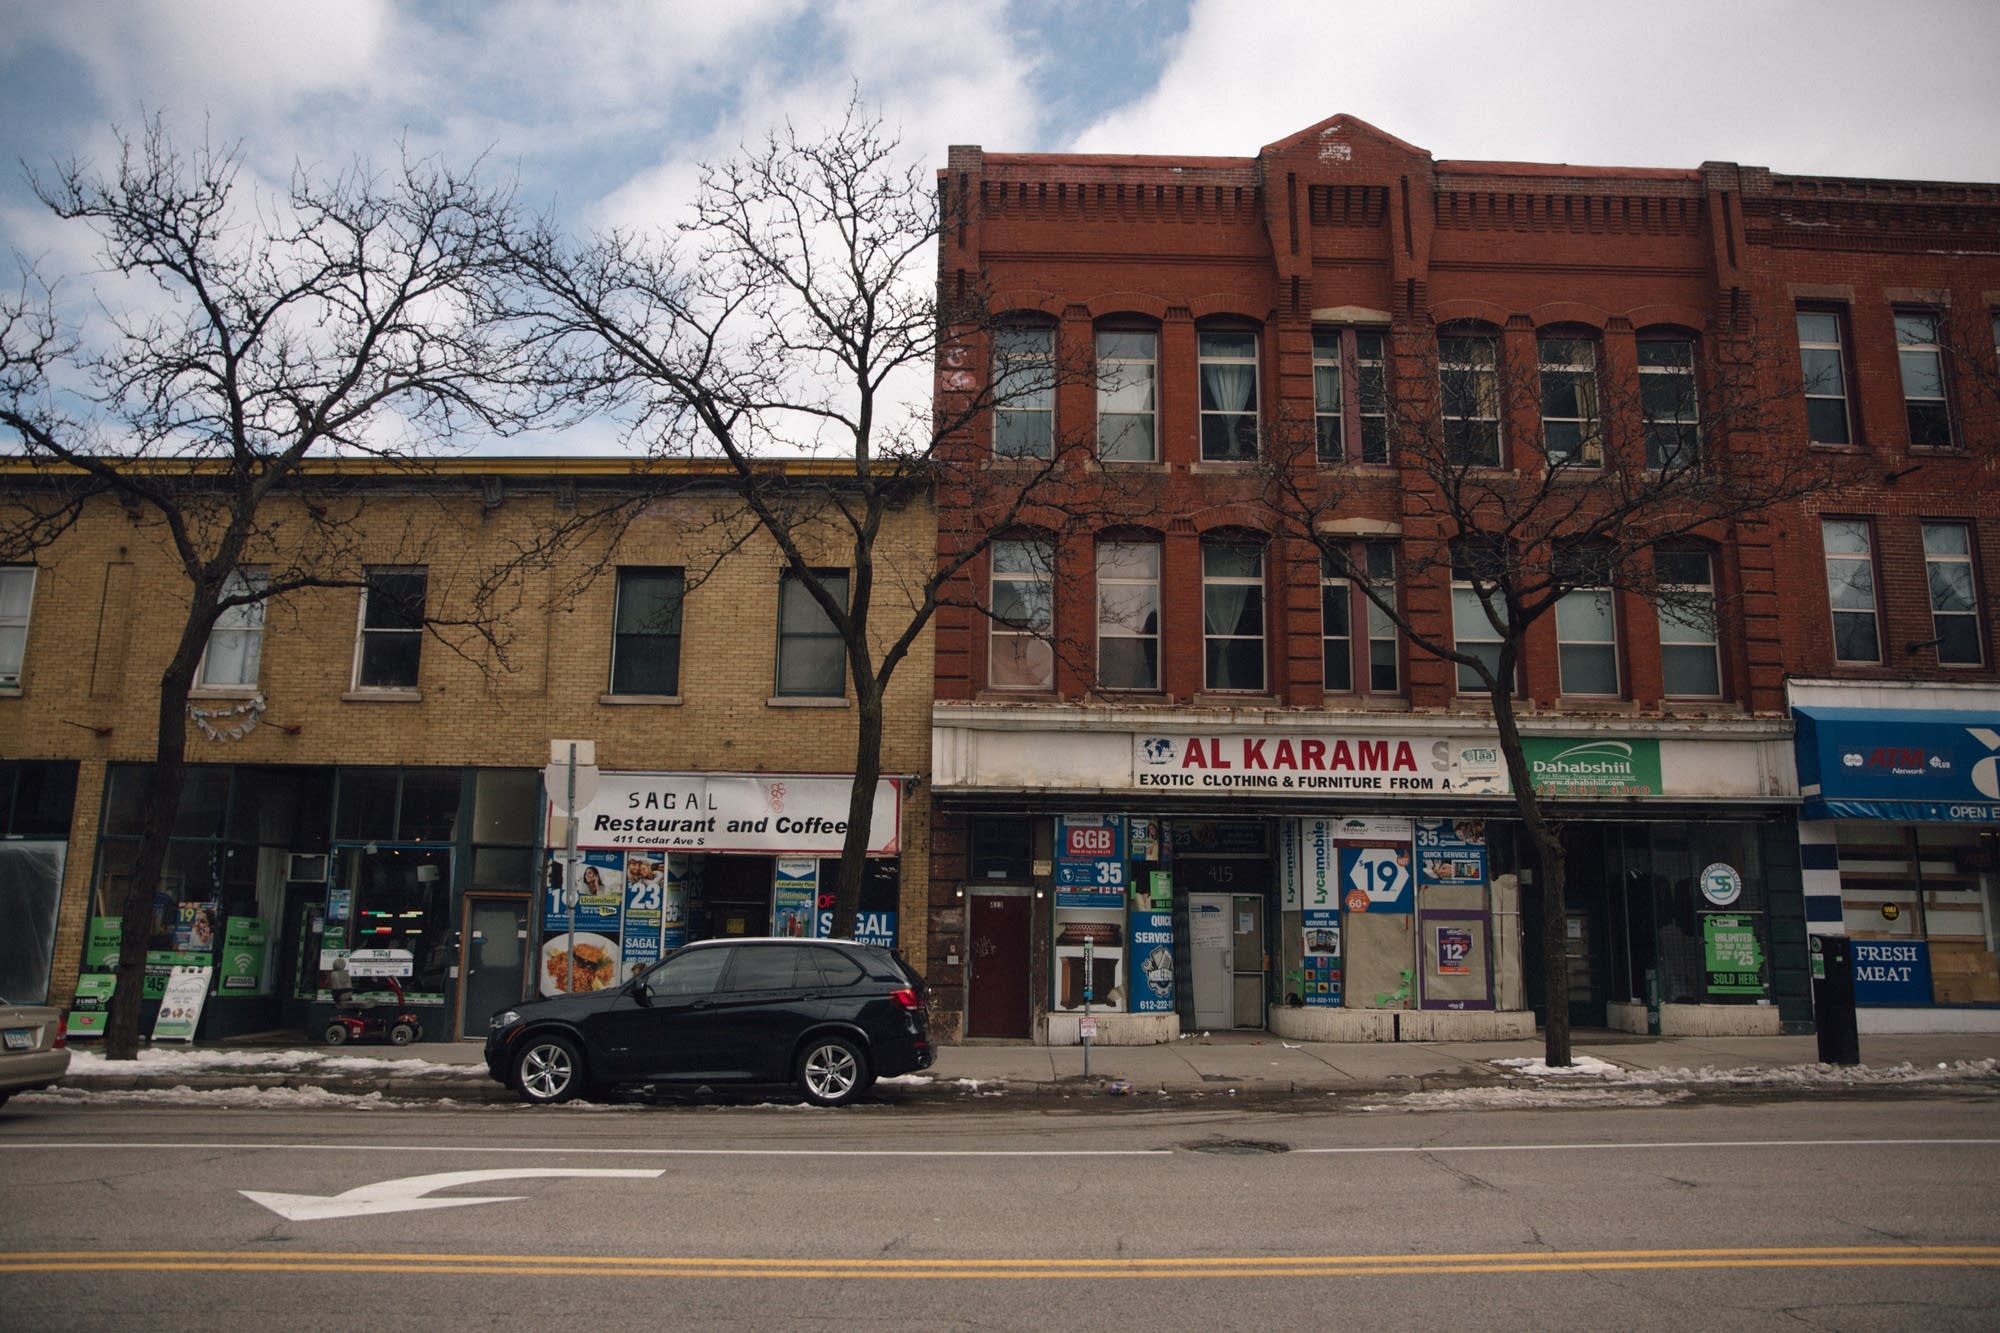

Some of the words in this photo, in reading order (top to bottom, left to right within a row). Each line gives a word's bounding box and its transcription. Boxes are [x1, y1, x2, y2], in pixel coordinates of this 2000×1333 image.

[1182, 738, 1231, 769] AL
[1243, 739, 1418, 772] KARAMA
[1868, 747, 1925, 769] ATM
[1533, 760, 1632, 774] Dahabshiil
[1139, 774, 1195, 787] EXOTIC
[1203, 775, 1280, 788] CLOTHING
[1282, 776, 1295, 789] &
[1298, 776, 1385, 790] FURNITURE
[1390, 778, 1434, 790] FROM
[629, 792, 718, 811] SAGAL
[1950, 805, 1988, 819] OPEN
[594, 814, 716, 834] Restaurant
[727, 817, 768, 834] and
[775, 817, 848, 835] Coffee
[613, 836, 633, 846] 411
[637, 837, 671, 847] Cedar
[673, 837, 693, 847] Ave
[697, 838, 705, 847] S
[1072, 829, 1111, 849] 6GB
[1286, 821, 1297, 904] Lycamobile
[1313, 821, 1328, 904] Lycamobile
[1095, 862, 1122, 884] $35
[1207, 865, 1233, 882] 415
[1359, 860, 1398, 891] $19
[628, 882, 661, 910] $23
[179, 908, 195, 923] 19
[1313, 911, 1331, 919] QUICK
[820, 911, 894, 936] SGAL
[625, 937, 659, 949] SAGAL
[1134, 931, 1171, 944] SERVICE
[1714, 933, 1753, 943] UNLIMITED
[1855, 946, 1918, 962] FRESH
[1712, 972, 1735, 985] SOLD
[1855, 966, 1912, 982] MEAT
